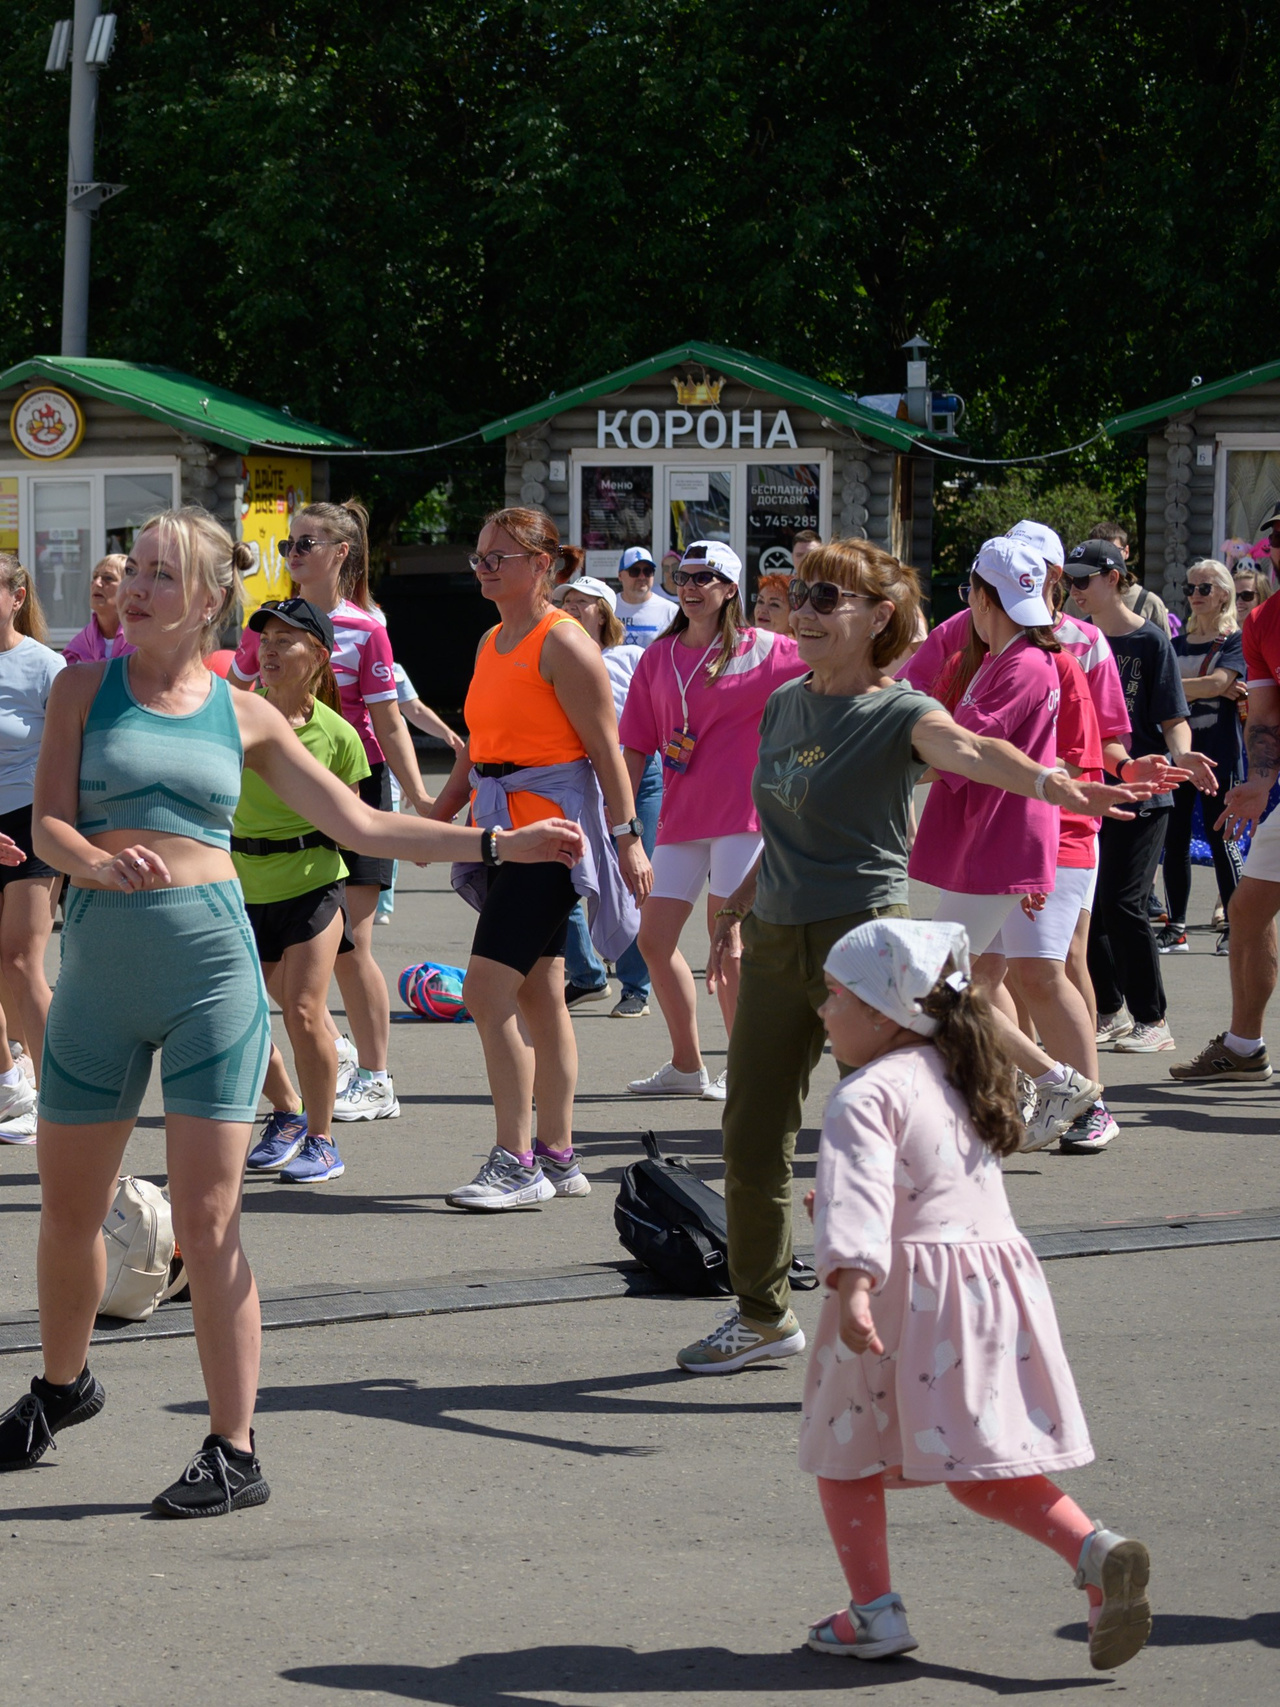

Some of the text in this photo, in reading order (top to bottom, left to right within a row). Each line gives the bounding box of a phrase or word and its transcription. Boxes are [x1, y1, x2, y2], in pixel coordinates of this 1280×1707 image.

[597, 409, 798, 449] КОРОНА
[601, 479, 633, 490] Меню
[751, 485, 817, 495] БЕСПЛАТНАЯ
[757, 495, 810, 506] ДОСТАВКА
[765, 515, 817, 527] 745-285
